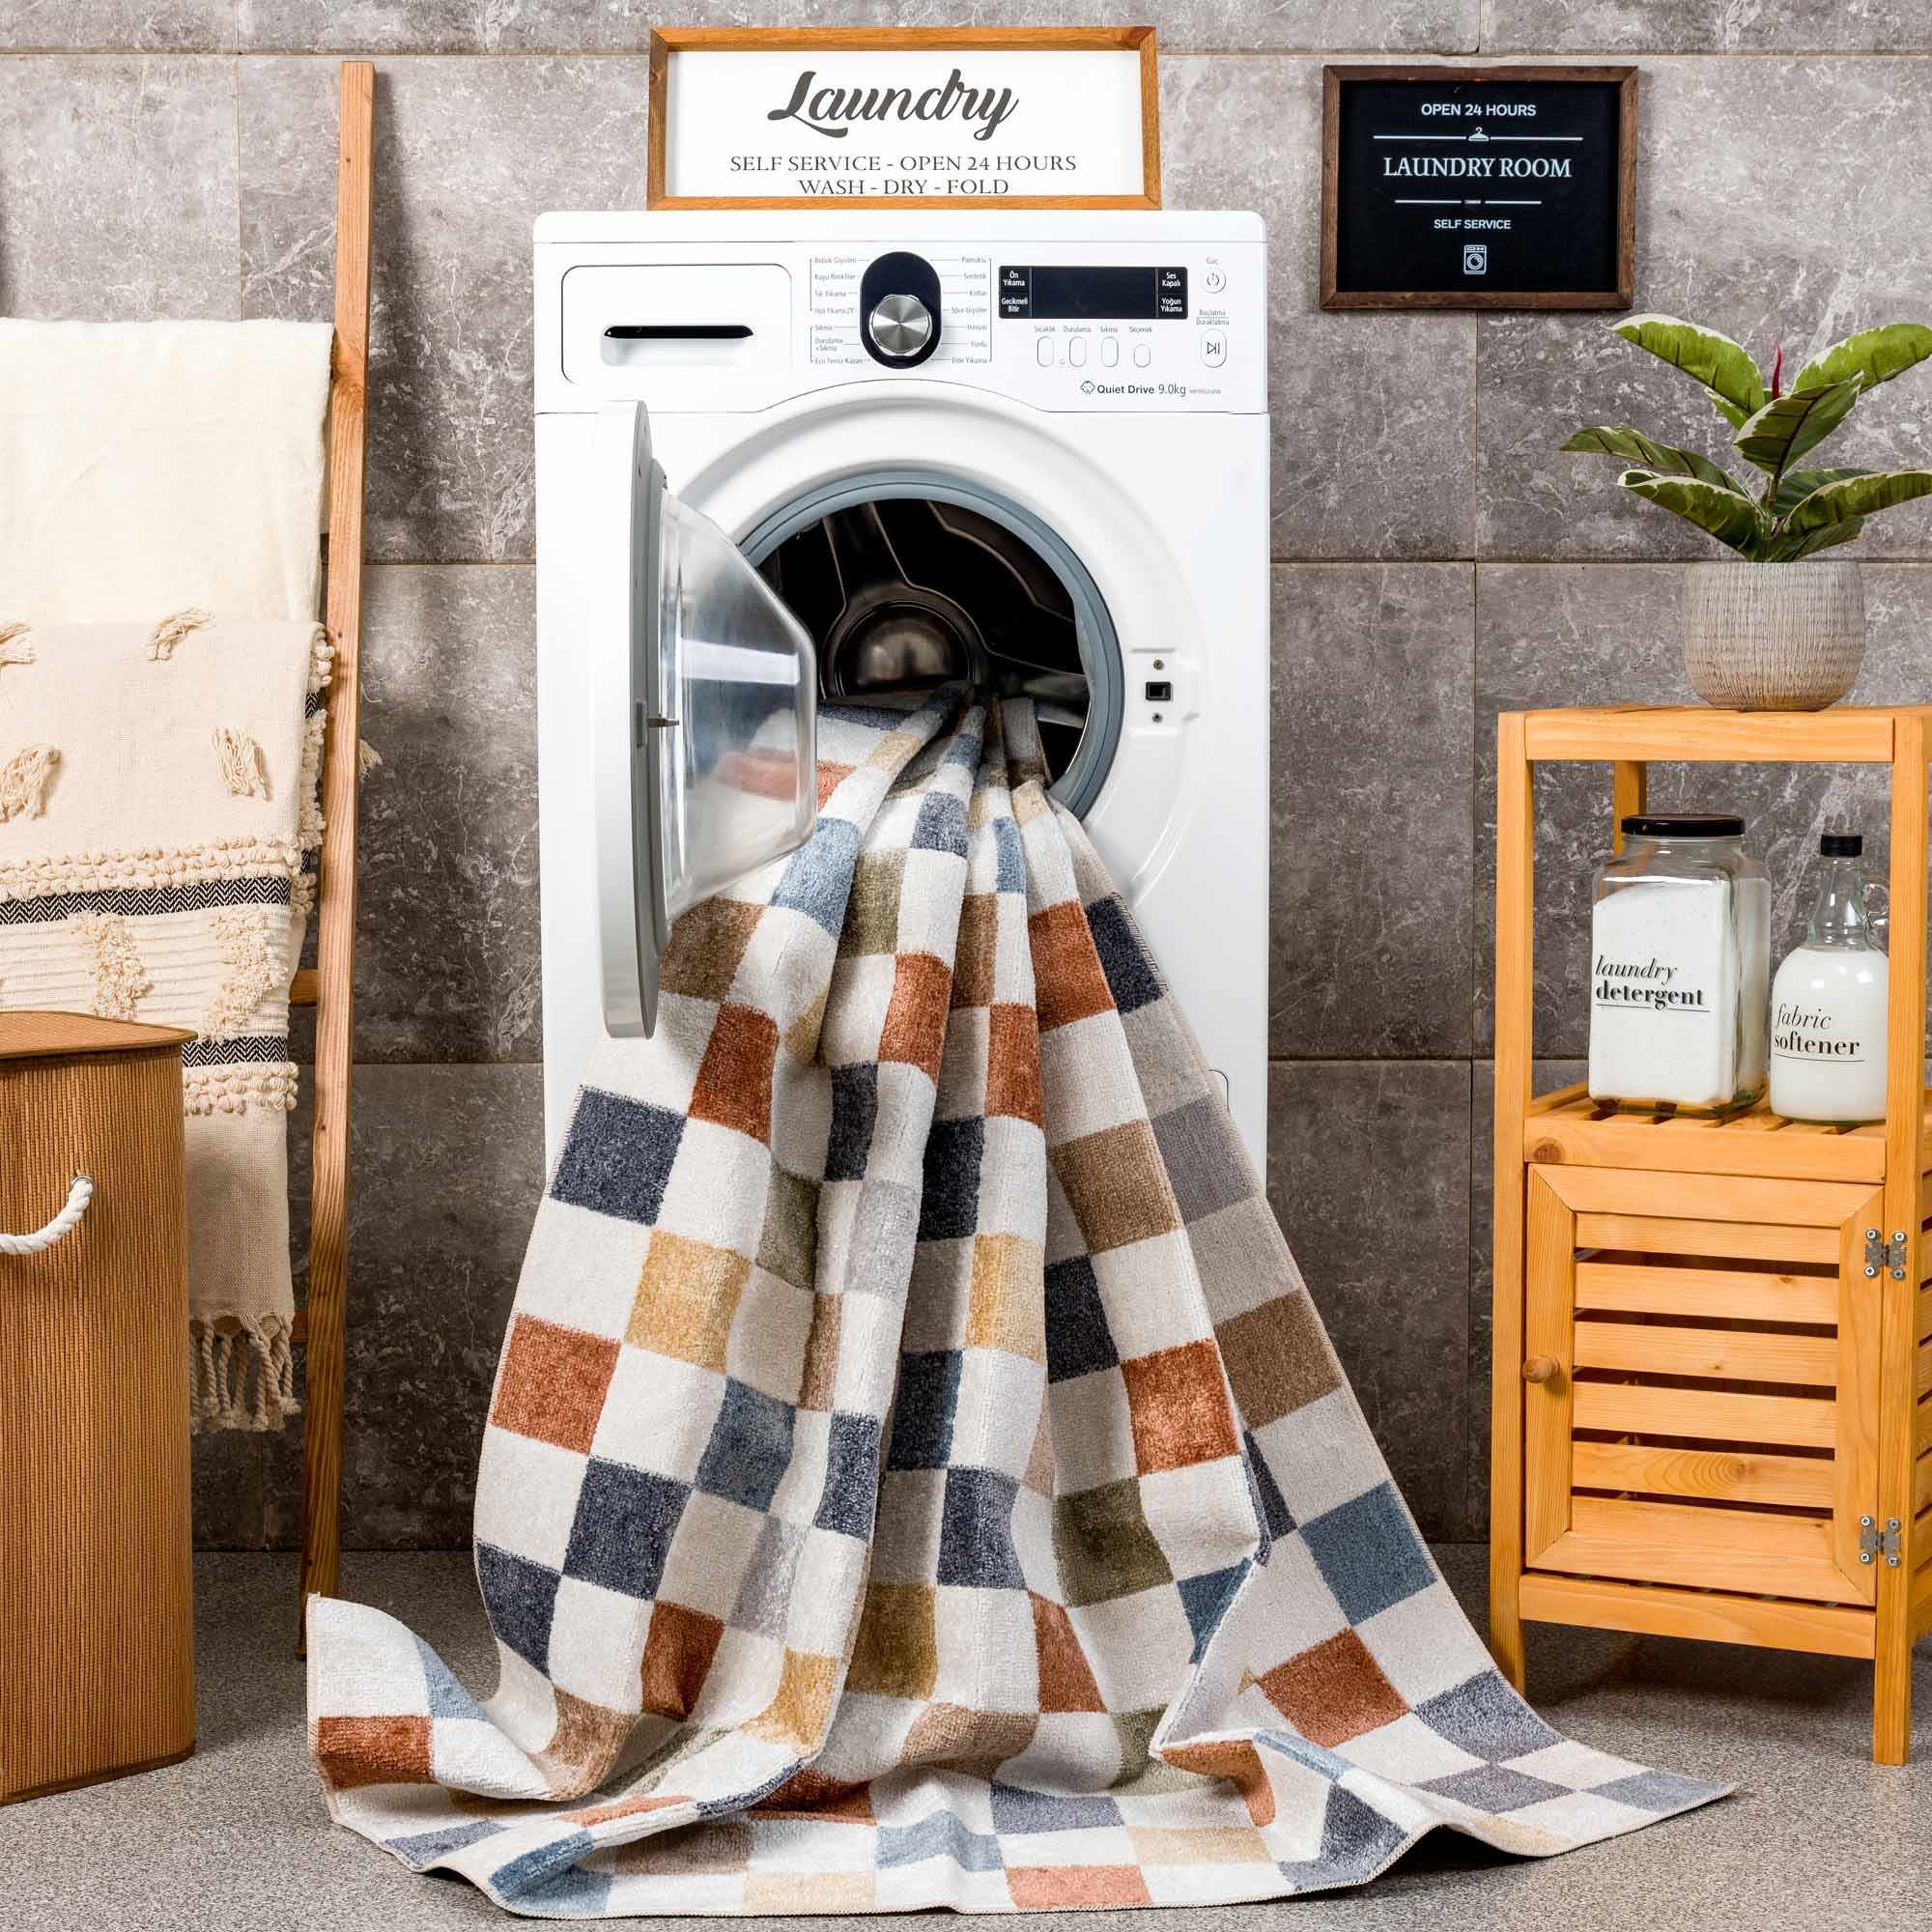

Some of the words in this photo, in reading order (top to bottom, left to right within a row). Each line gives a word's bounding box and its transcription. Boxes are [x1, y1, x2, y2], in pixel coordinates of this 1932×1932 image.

[766, 68, 1020, 142] Laundry
[1420, 102, 1462, 117] OPEN
[1463, 103, 1484, 117] 24
[1485, 103, 1537, 117] HOURS
[730, 156, 782, 172] SELF
[787, 156, 881, 171] SERVICE
[899, 156, 961, 171] OPEN
[966, 156, 990, 171] 24
[996, 155, 1077, 171] HOURS
[1382, 156, 1496, 178] LAUNDRY
[1498, 156, 1573, 178] ROOM
[798, 179, 865, 195] WASH
[884, 179, 928, 195] DRY
[947, 179, 1009, 194] FOLD
[1433, 218, 1463, 230] SELF
[1463, 218, 1512, 230] SERVICE
[1001, 297, 1029, 305] Gecikmeli
[1008, 304, 1020, 313] Bitir
[1161, 298, 1182, 306] Yoğun
[1096, 384, 1125, 394] Quiet
[1127, 384, 1155, 395] Drive
[1157, 383, 1186, 398] 9.0kg
[1595, 955, 1678, 986] laundry
[1596, 980, 1705, 1010] detergent
[1776, 1003, 1833, 1030] fabric
[1774, 1031, 1861, 1056] softener
